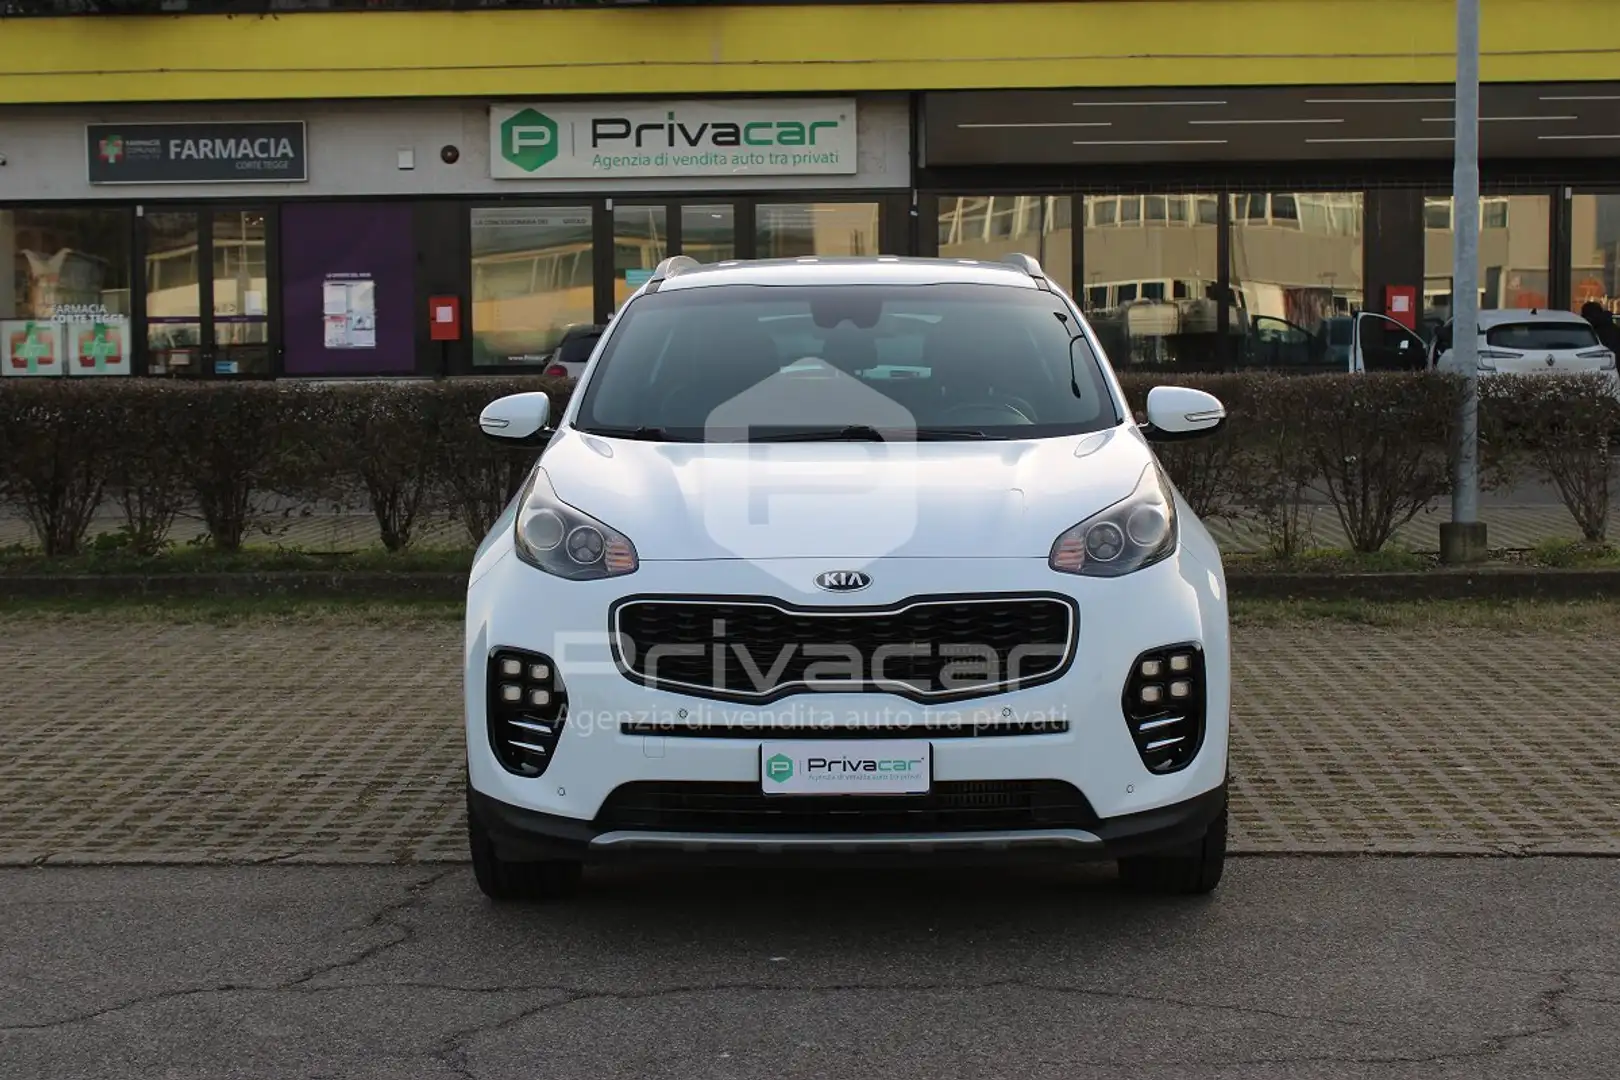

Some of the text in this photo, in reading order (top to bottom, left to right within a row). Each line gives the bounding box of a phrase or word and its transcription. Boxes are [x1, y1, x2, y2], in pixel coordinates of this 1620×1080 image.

[592, 111, 839, 148] Privacar
[169, 138, 295, 160] FARMACIA
[235, 160, 261, 170] CORTE
[592, 151, 839, 169] Agenzia di vendita auto tra privati
[52, 303, 108, 314] FARMACIA
[824, 572, 863, 586] KIA
[807, 756, 922, 772] Privacar
